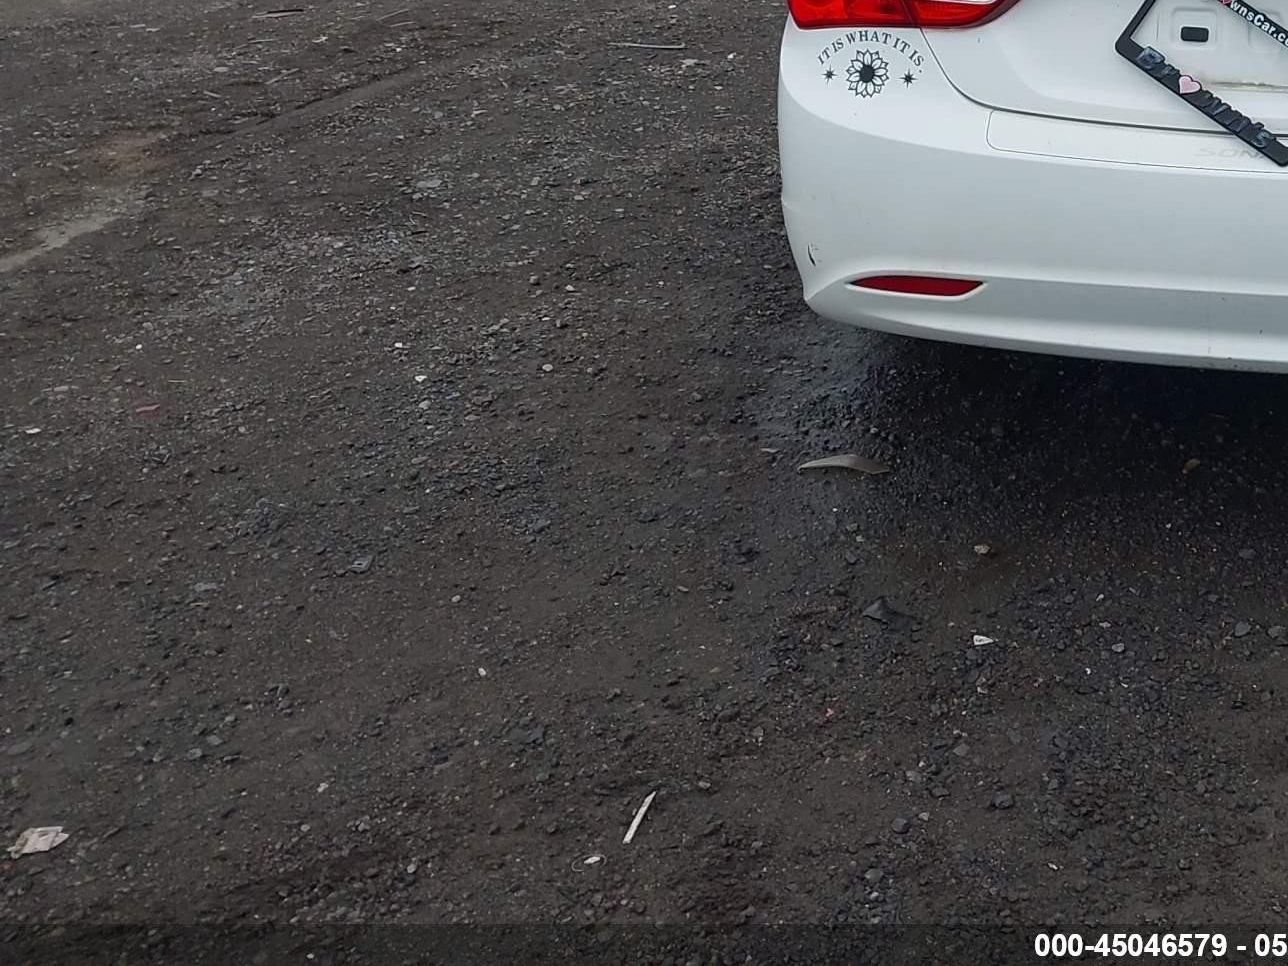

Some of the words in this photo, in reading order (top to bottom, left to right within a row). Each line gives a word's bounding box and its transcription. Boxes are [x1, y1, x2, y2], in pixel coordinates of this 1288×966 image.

[817, 46, 831, 66] IT
[831, 37, 845, 53] IS
[845, 30, 892, 45] WHAT
[892, 38, 911, 54] IT
